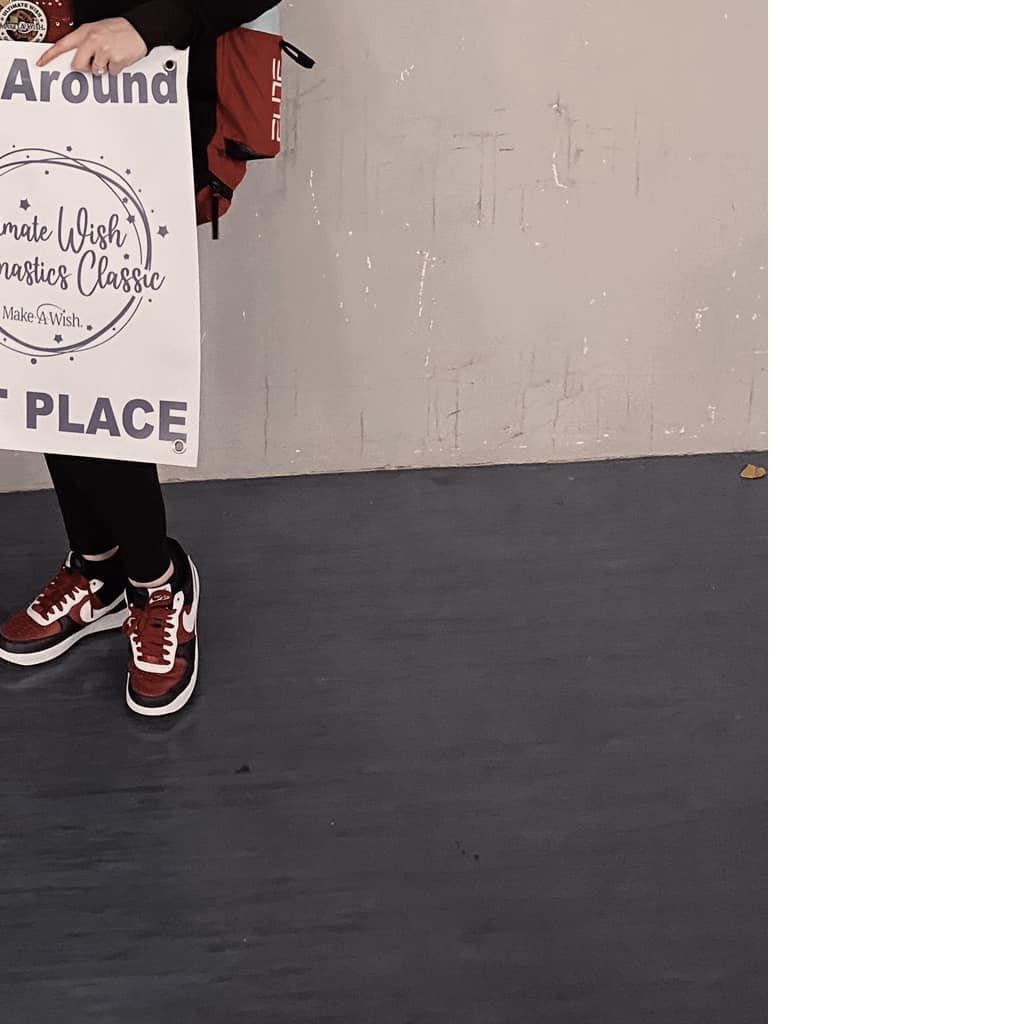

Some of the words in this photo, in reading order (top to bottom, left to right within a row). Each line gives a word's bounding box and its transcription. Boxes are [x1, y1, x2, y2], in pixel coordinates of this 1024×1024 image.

[1, 58, 179, 105] Around
[57, 206, 128, 254] Wish
[77, 249, 166, 297] Classic
[26, 391, 188, 443] PLACE
